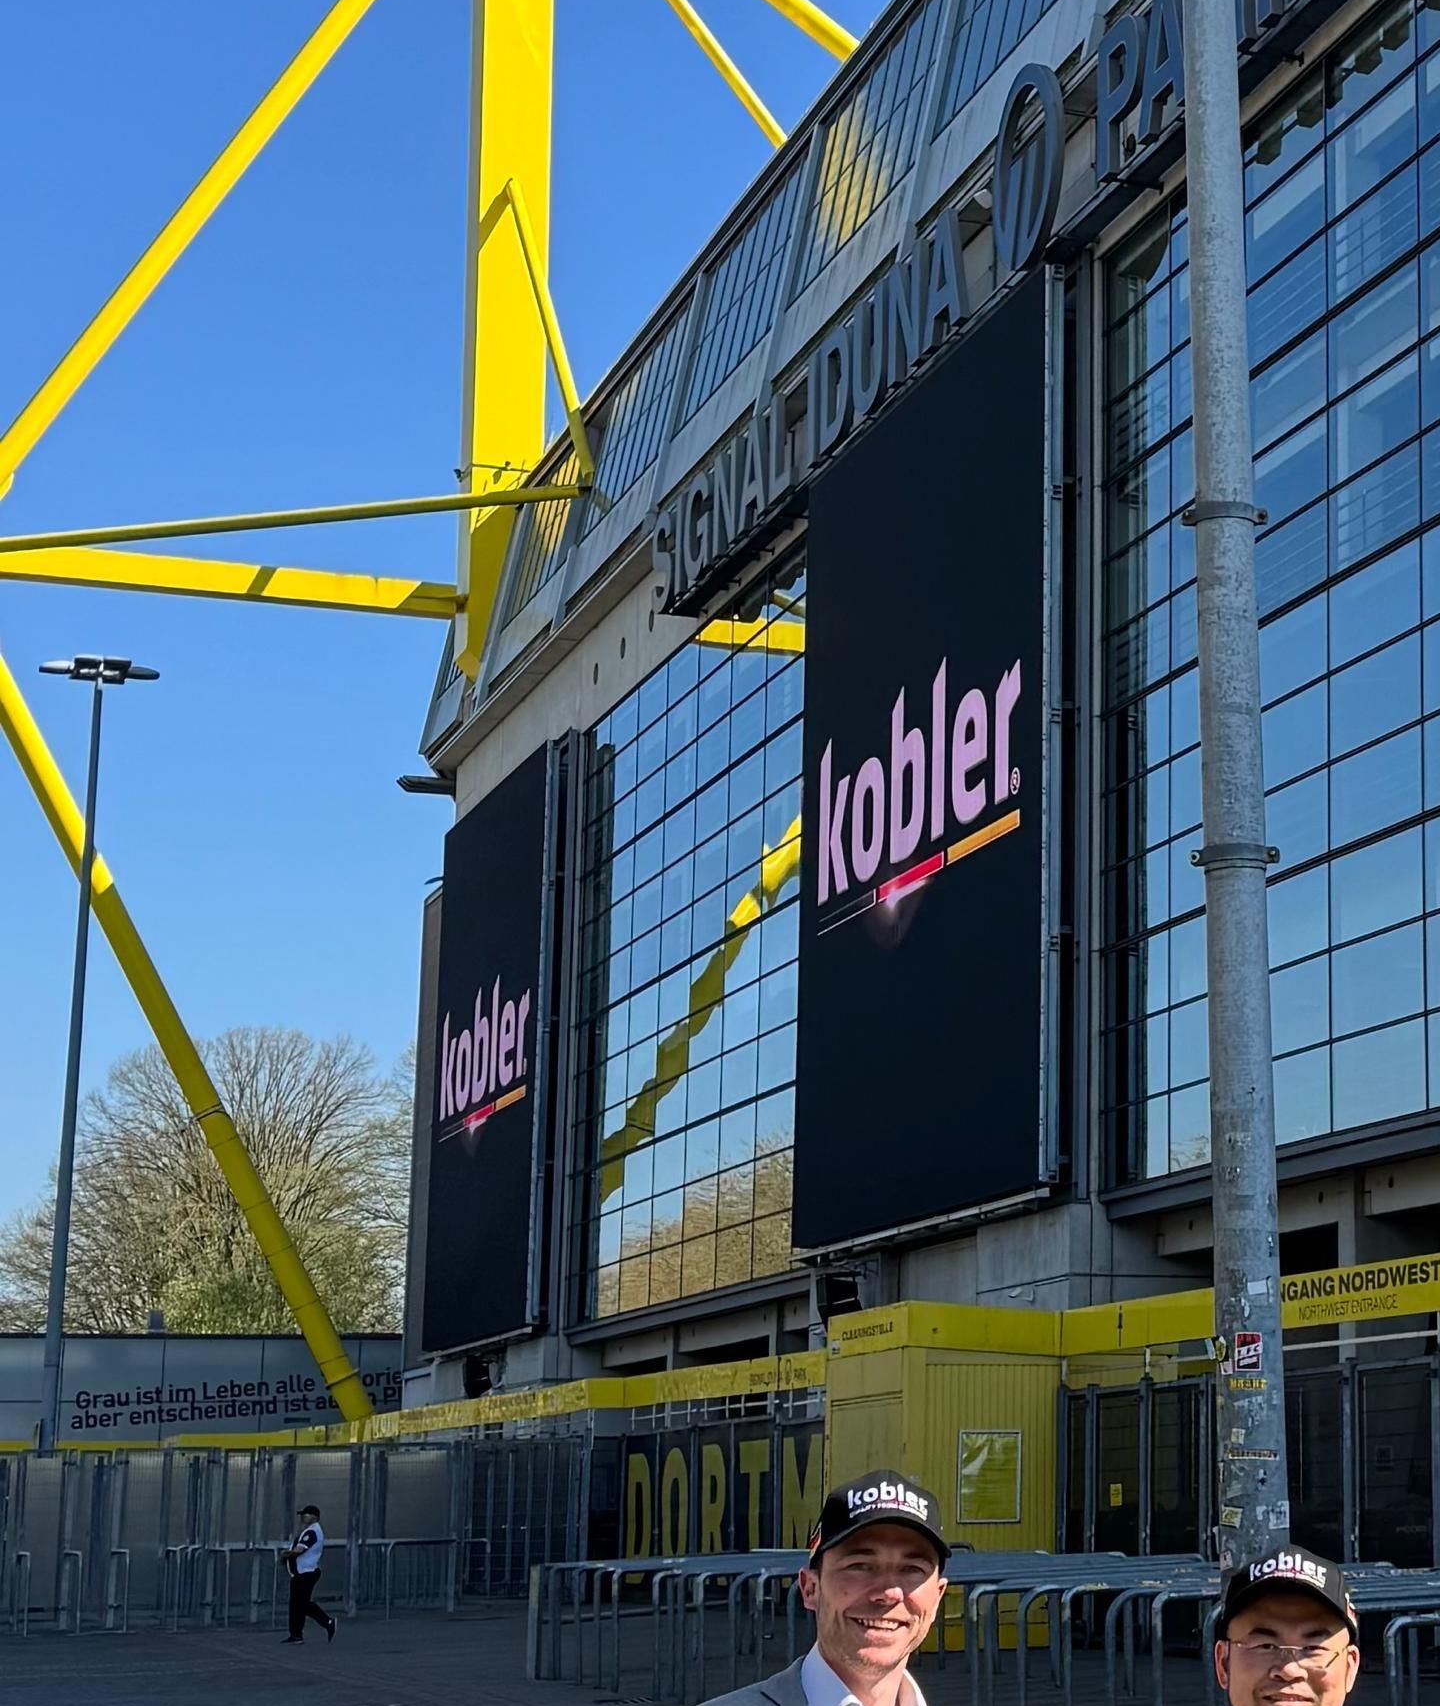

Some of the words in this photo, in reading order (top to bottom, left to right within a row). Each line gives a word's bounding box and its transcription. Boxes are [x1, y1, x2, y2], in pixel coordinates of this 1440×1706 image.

[652, 392, 800, 615] SIGNAL
[807, 207, 969, 469] IDUNA
[440, 974, 530, 1122] kobler
[1300, 1300, 1350, 1321] NORTHWEST
[1351, 1294, 1399, 1314] ENTRANCE
[76, 1390, 130, 1410] Grau
[136, 1386, 163, 1405] ist
[169, 1384, 195, 1402] im
[203, 1377, 268, 1400] Leben
[276, 1374, 315, 1394] alle
[71, 1409, 123, 1430] aber
[130, 1395, 278, 1425] entscheidend
[284, 1394, 311, 1413] ist
[847, 1481, 929, 1512] kobler
[1249, 1552, 1328, 1582] kobler
